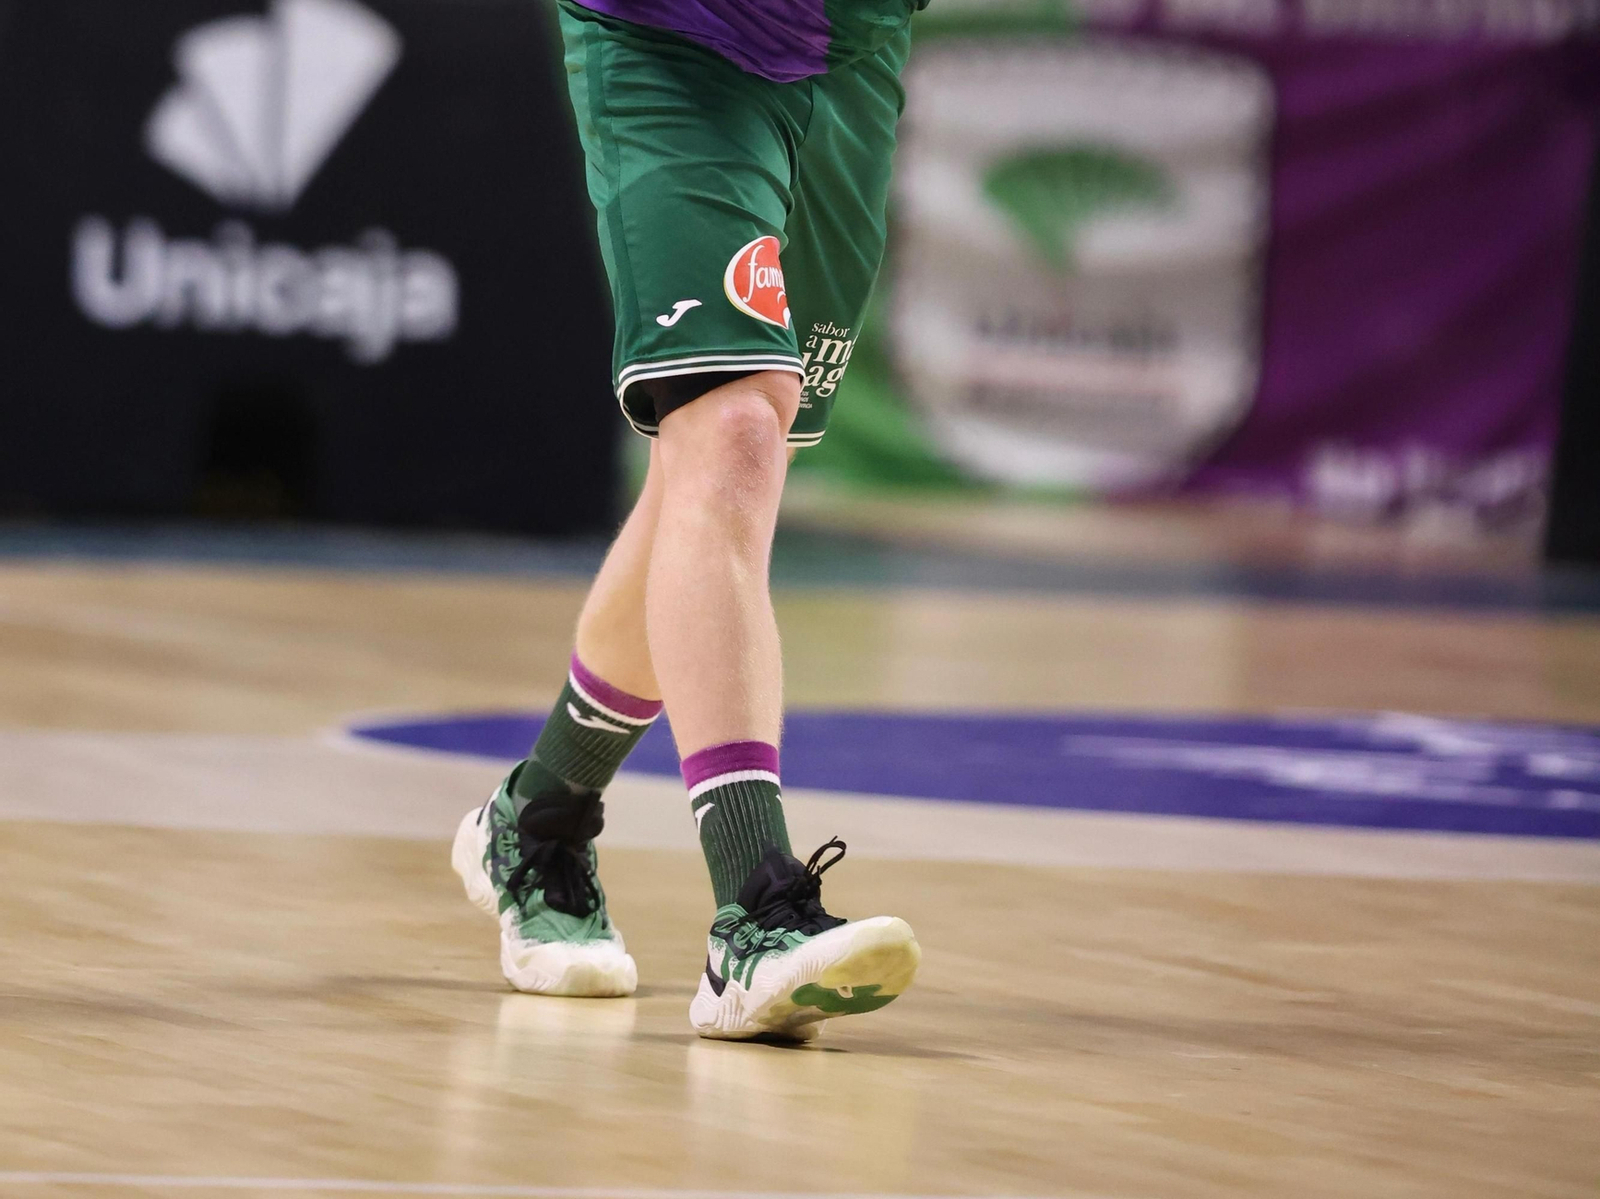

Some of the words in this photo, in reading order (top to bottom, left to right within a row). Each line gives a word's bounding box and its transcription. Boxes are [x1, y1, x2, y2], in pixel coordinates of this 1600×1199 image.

[72, 214, 458, 364] Unicaja
[811, 321, 850, 337] sabor
[805, 334, 818, 349] a
